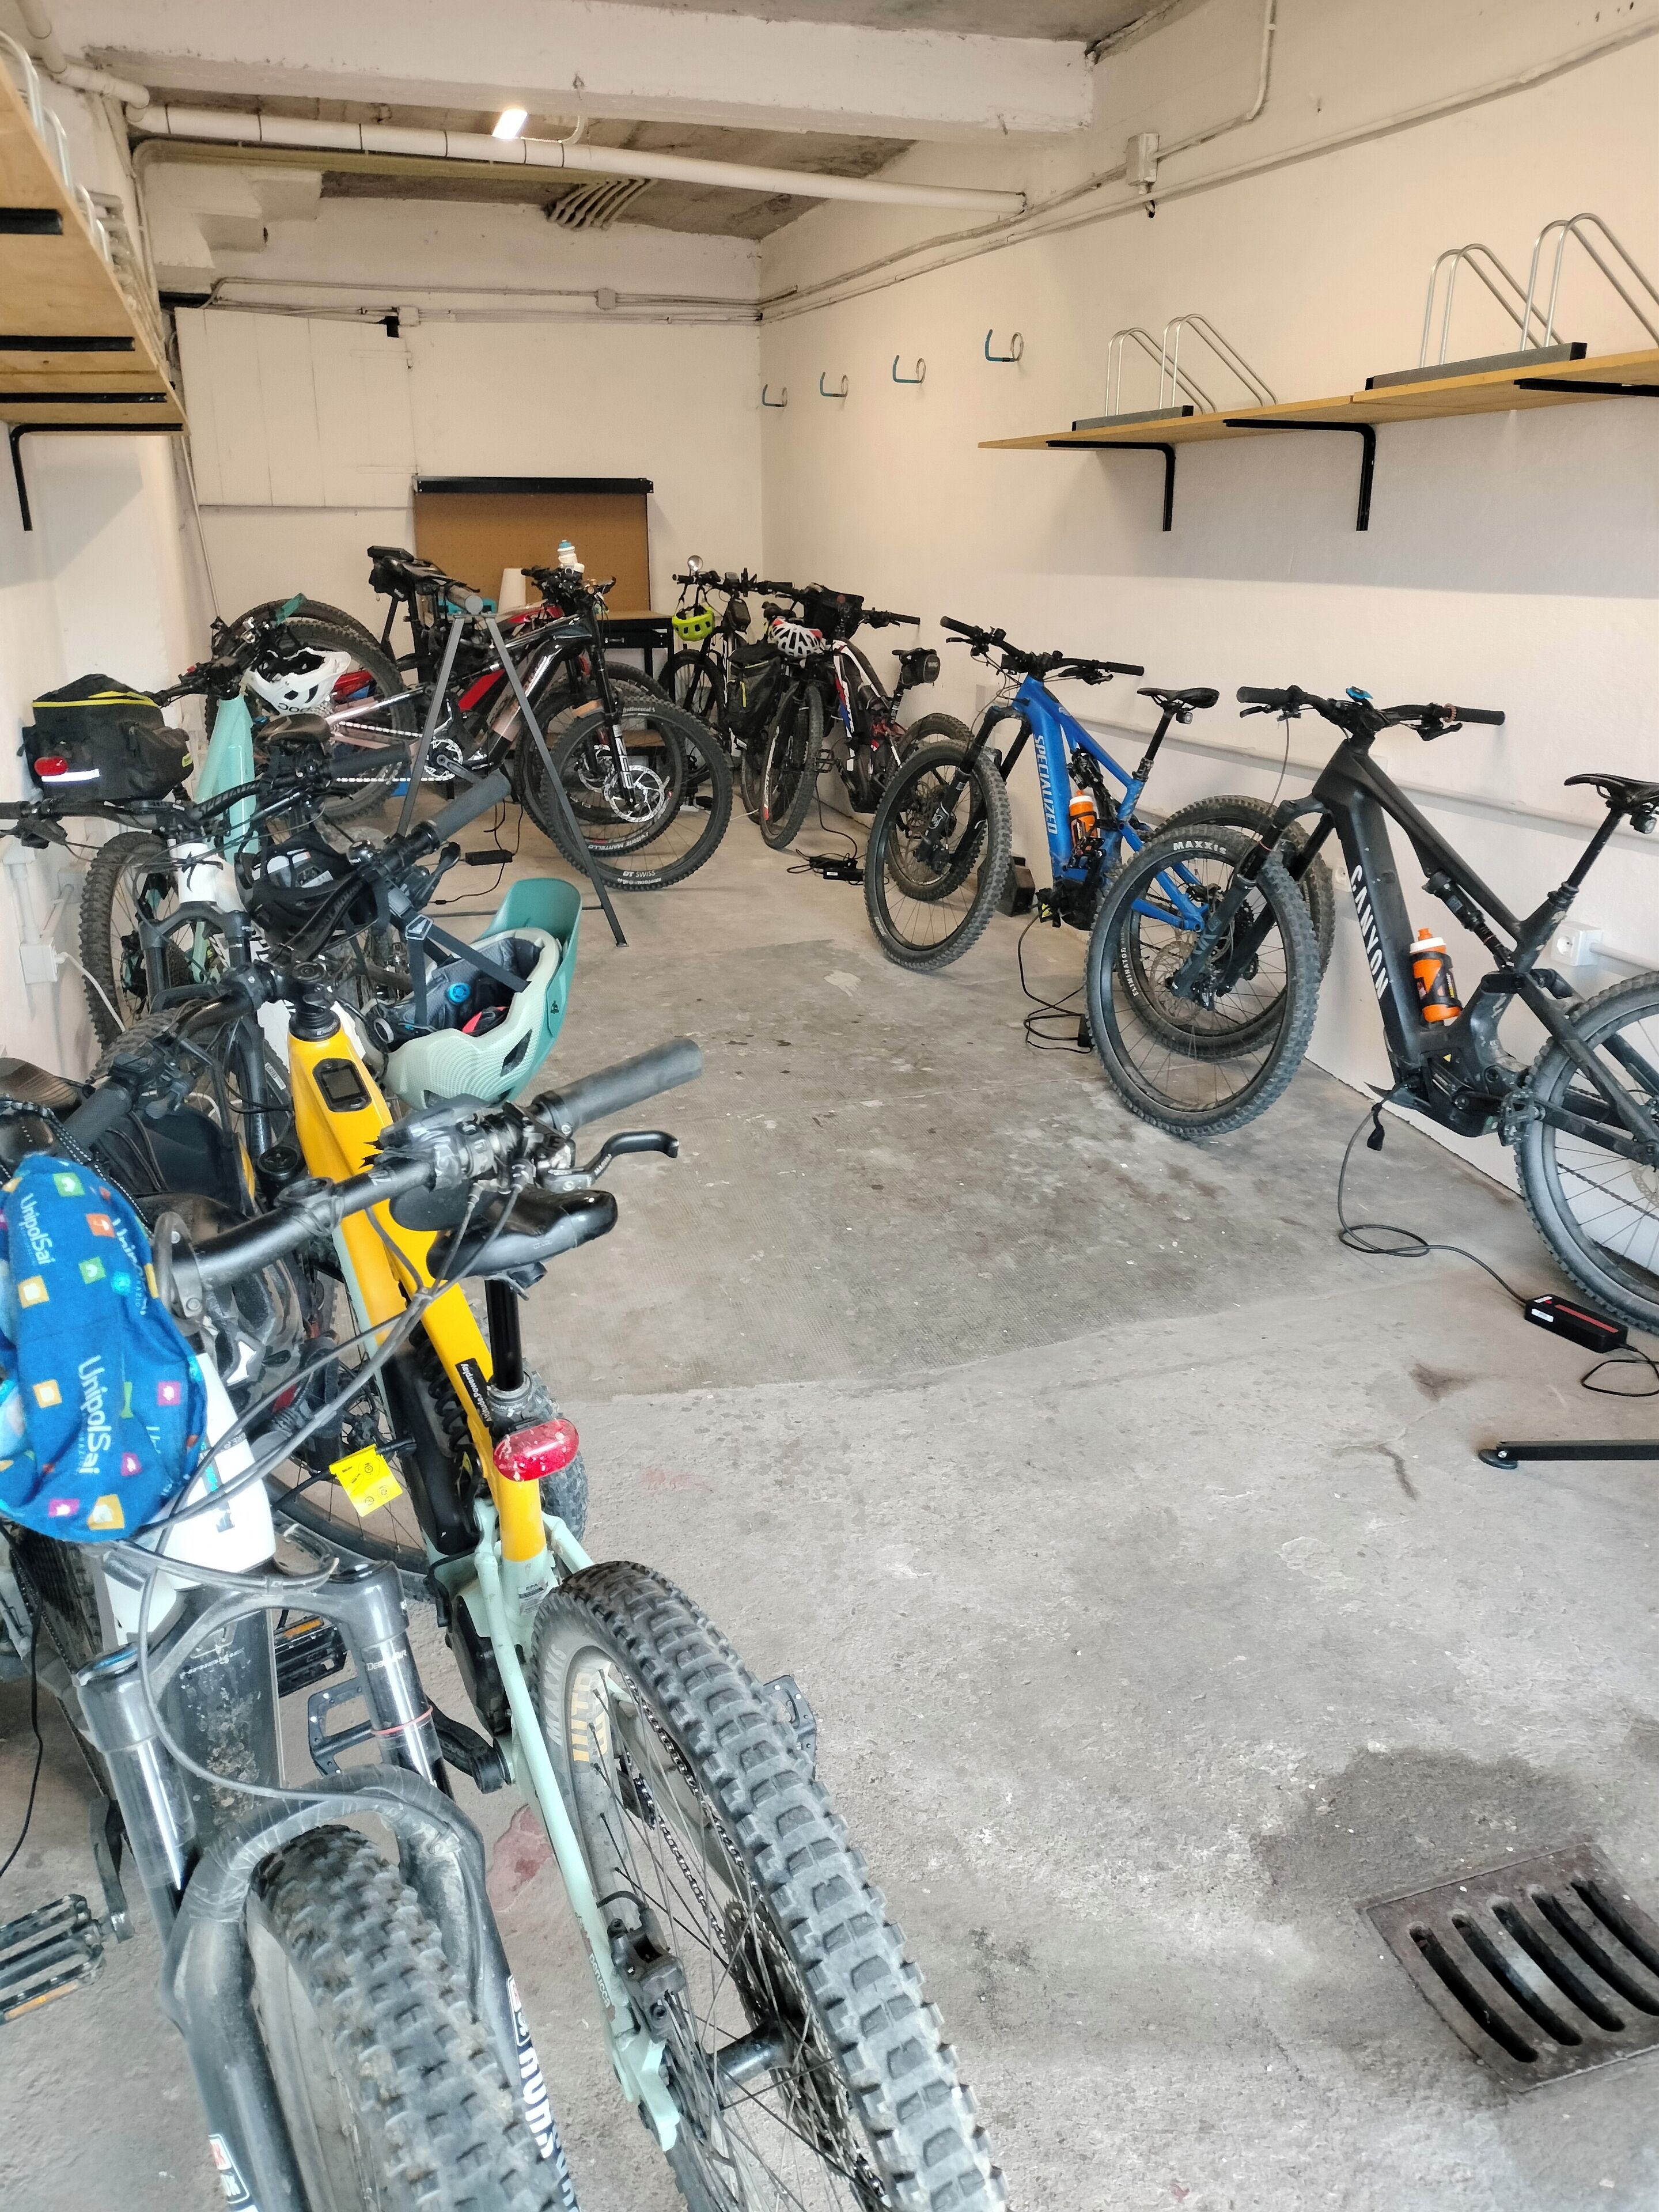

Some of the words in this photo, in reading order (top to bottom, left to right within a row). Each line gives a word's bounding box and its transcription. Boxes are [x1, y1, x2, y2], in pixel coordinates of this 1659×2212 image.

[1035, 734, 1058, 835] SPECIALIZED
[635, 870, 656, 878] SWISS
[1173, 840, 1228, 855] MAXXIS
[1350, 865, 1389, 1000] CANYON
[1120, 947, 1139, 997] ELIMINATOR
[19, 1192, 56, 1265] UnipolSai
[78, 1355, 112, 1474] UnipolSai
[366, 1649, 407, 1671] DEBAIR
[544, 1643, 567, 1747] MAXXIS
